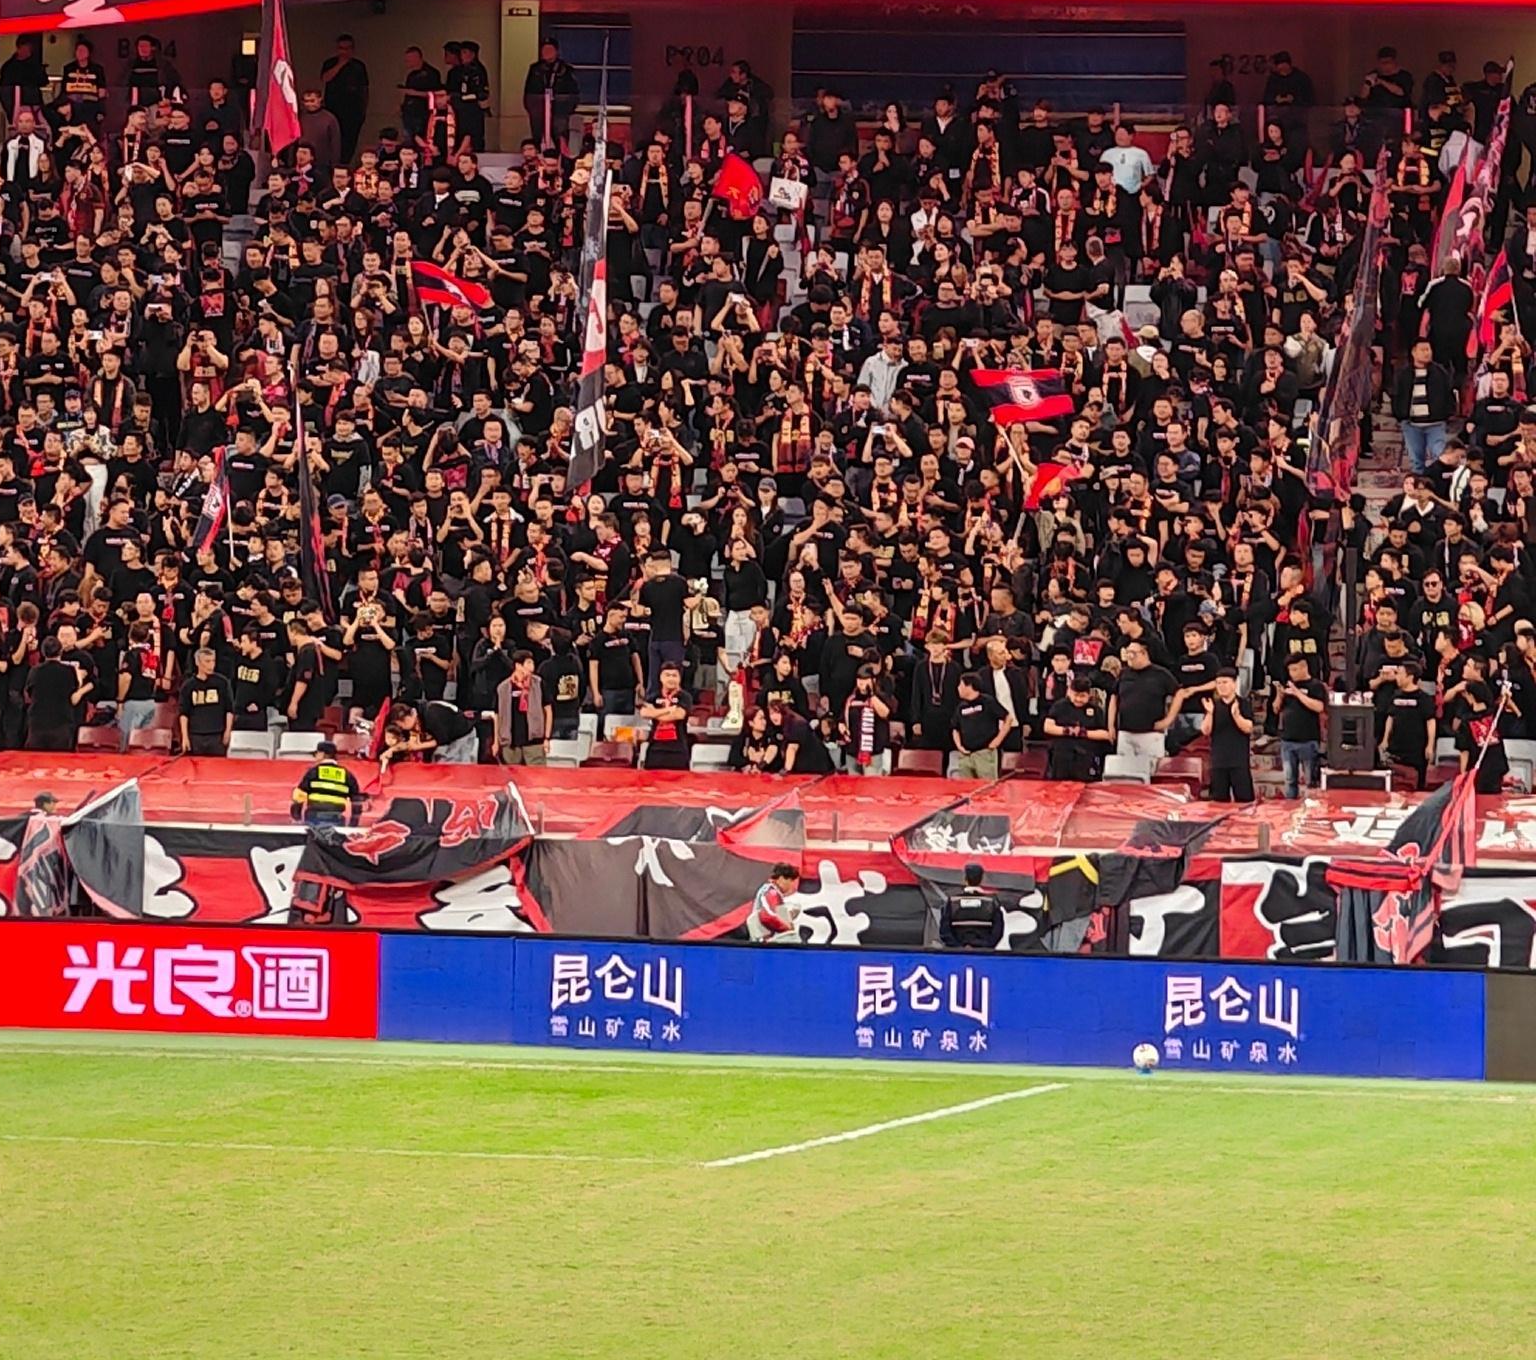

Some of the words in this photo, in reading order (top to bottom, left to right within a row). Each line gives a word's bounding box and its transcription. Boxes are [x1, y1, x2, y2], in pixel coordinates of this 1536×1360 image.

[550, 953, 683, 1018] 昆仑山
[856, 965, 990, 1029] 昆仑山
[1164, 976, 1299, 1041] 昆仑山
[549, 1015, 682, 1043] 雪山矿泉水
[855, 1026, 988, 1054] 雪山矿泉水
[1163, 1037, 1298, 1065] 雪山矿泉水
